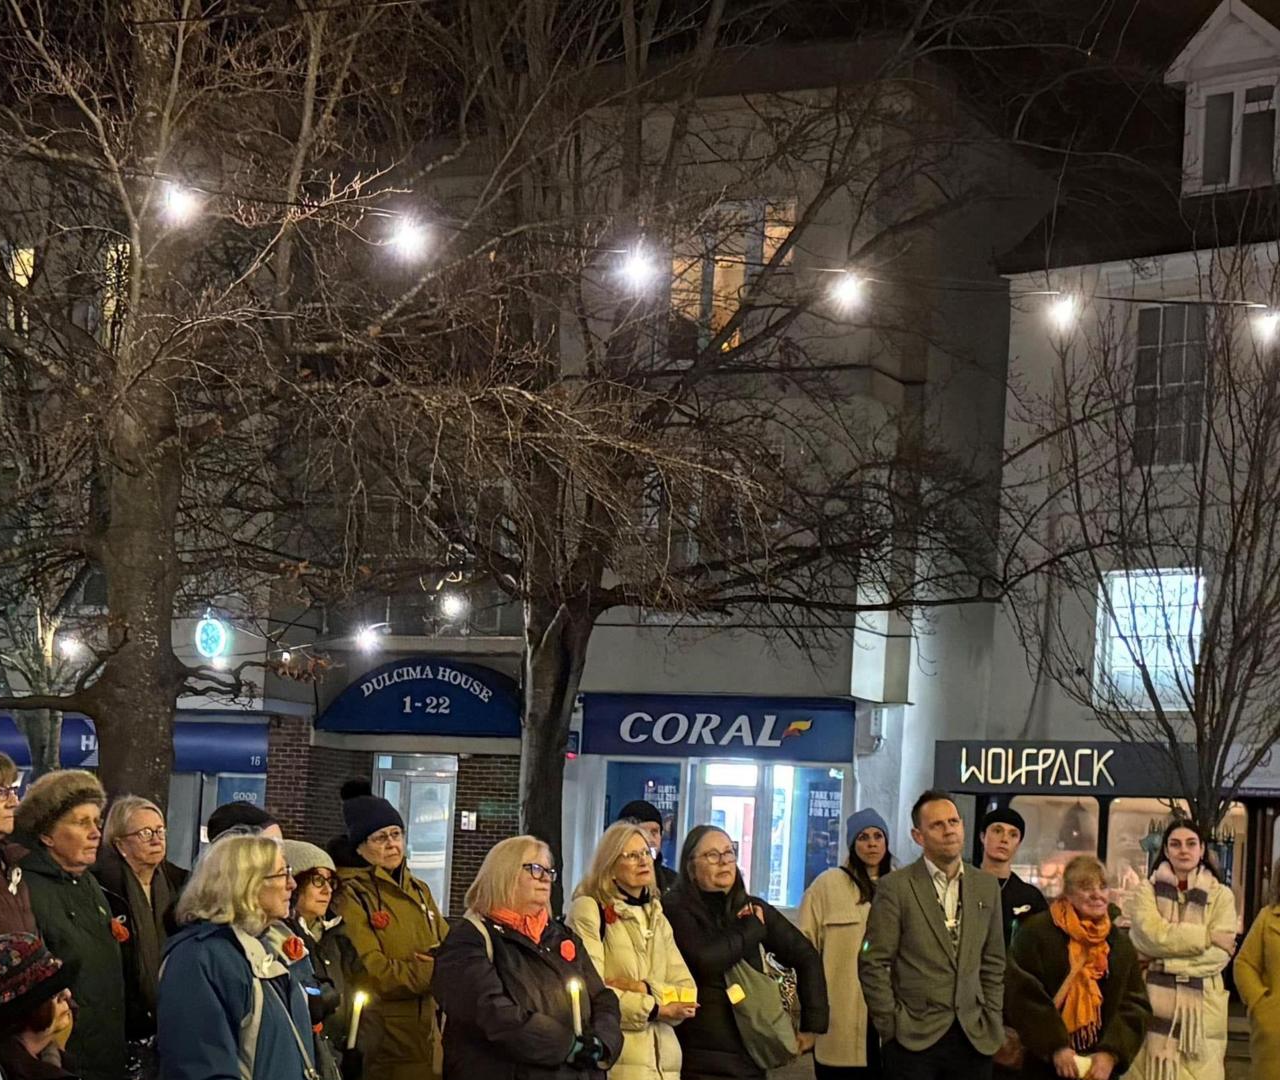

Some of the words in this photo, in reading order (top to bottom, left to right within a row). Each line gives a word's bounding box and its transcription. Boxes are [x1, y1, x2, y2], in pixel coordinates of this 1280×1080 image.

[360, 665, 434, 697] DULCIMA
[437, 666, 493, 703] HOUSE
[402, 695, 450, 714] 1-22
[619, 711, 782, 747] CORAL
[960, 747, 1115, 787] WOLFPACK
[232, 791, 257, 801] GOOD
